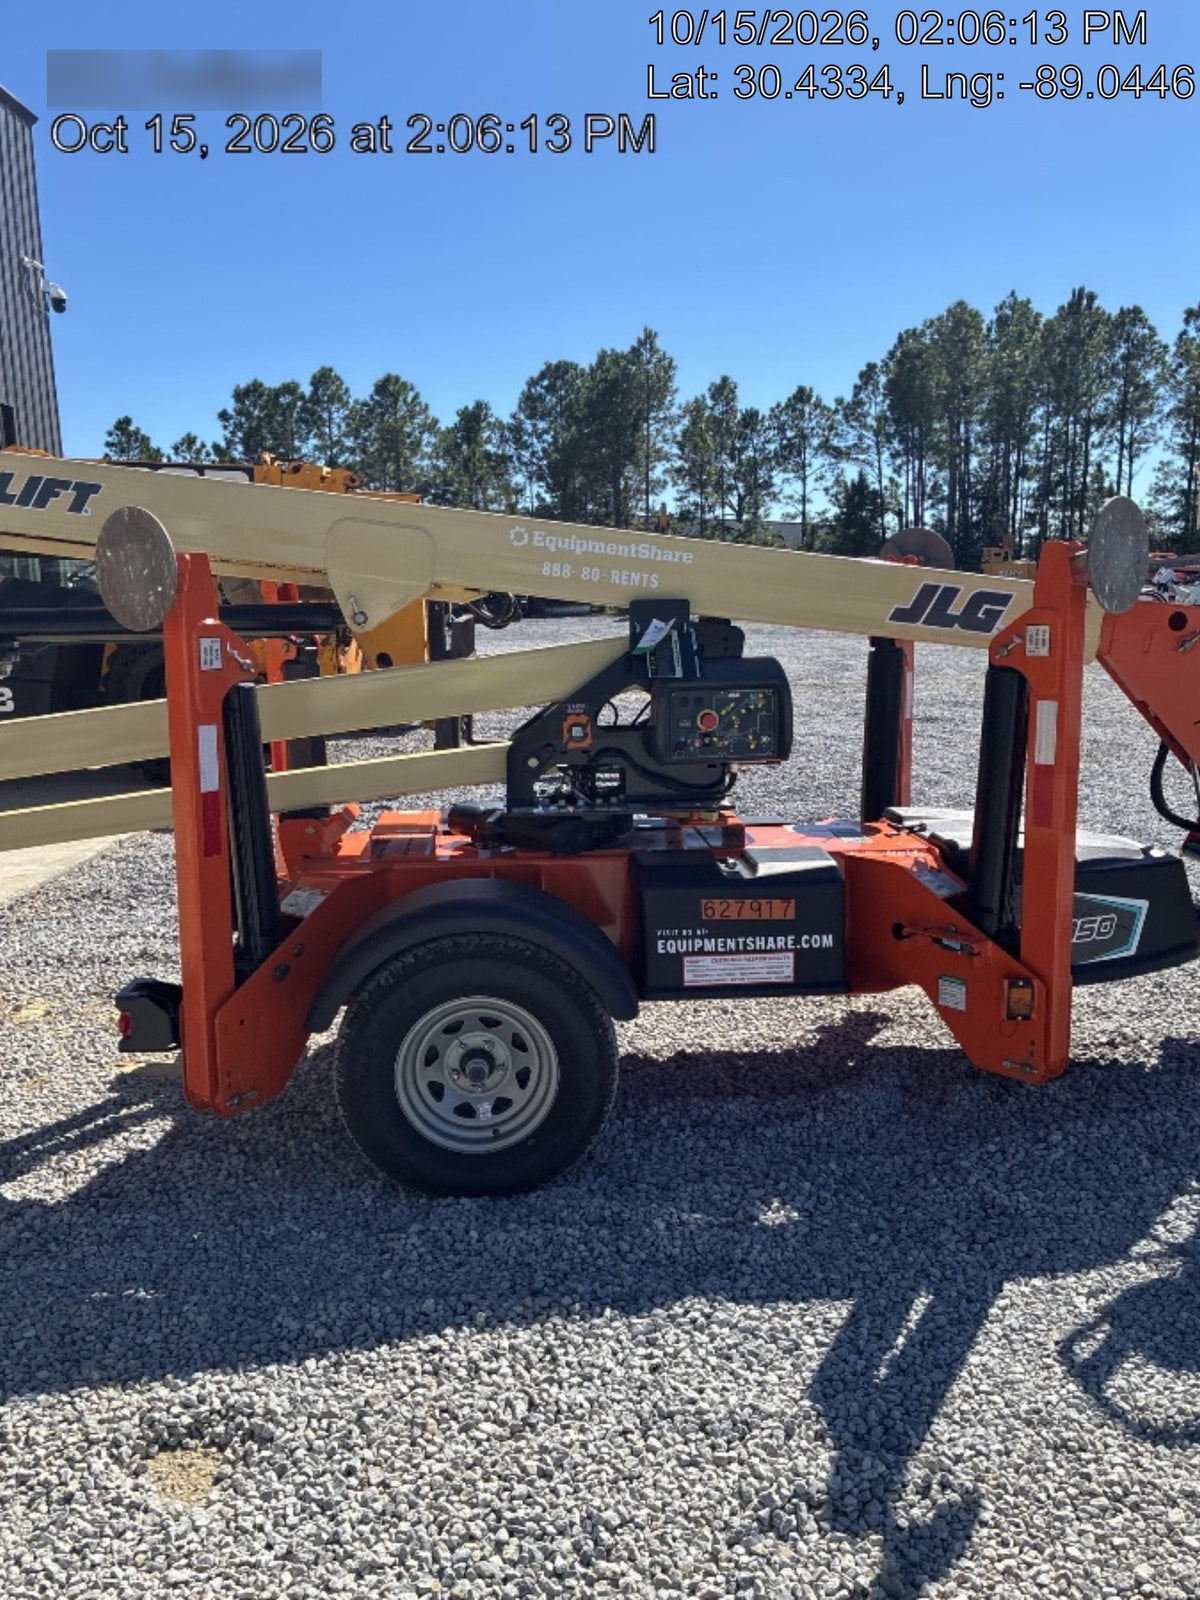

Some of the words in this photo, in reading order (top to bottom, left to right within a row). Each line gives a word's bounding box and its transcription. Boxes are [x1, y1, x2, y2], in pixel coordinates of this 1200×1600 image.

[533, 530, 695, 564] EquipmentShare
[886, 581, 1017, 634] JLG
[703, 901, 793, 918] 627917
[657, 934, 834, 954] EQUIPMENTSHARE.COM
